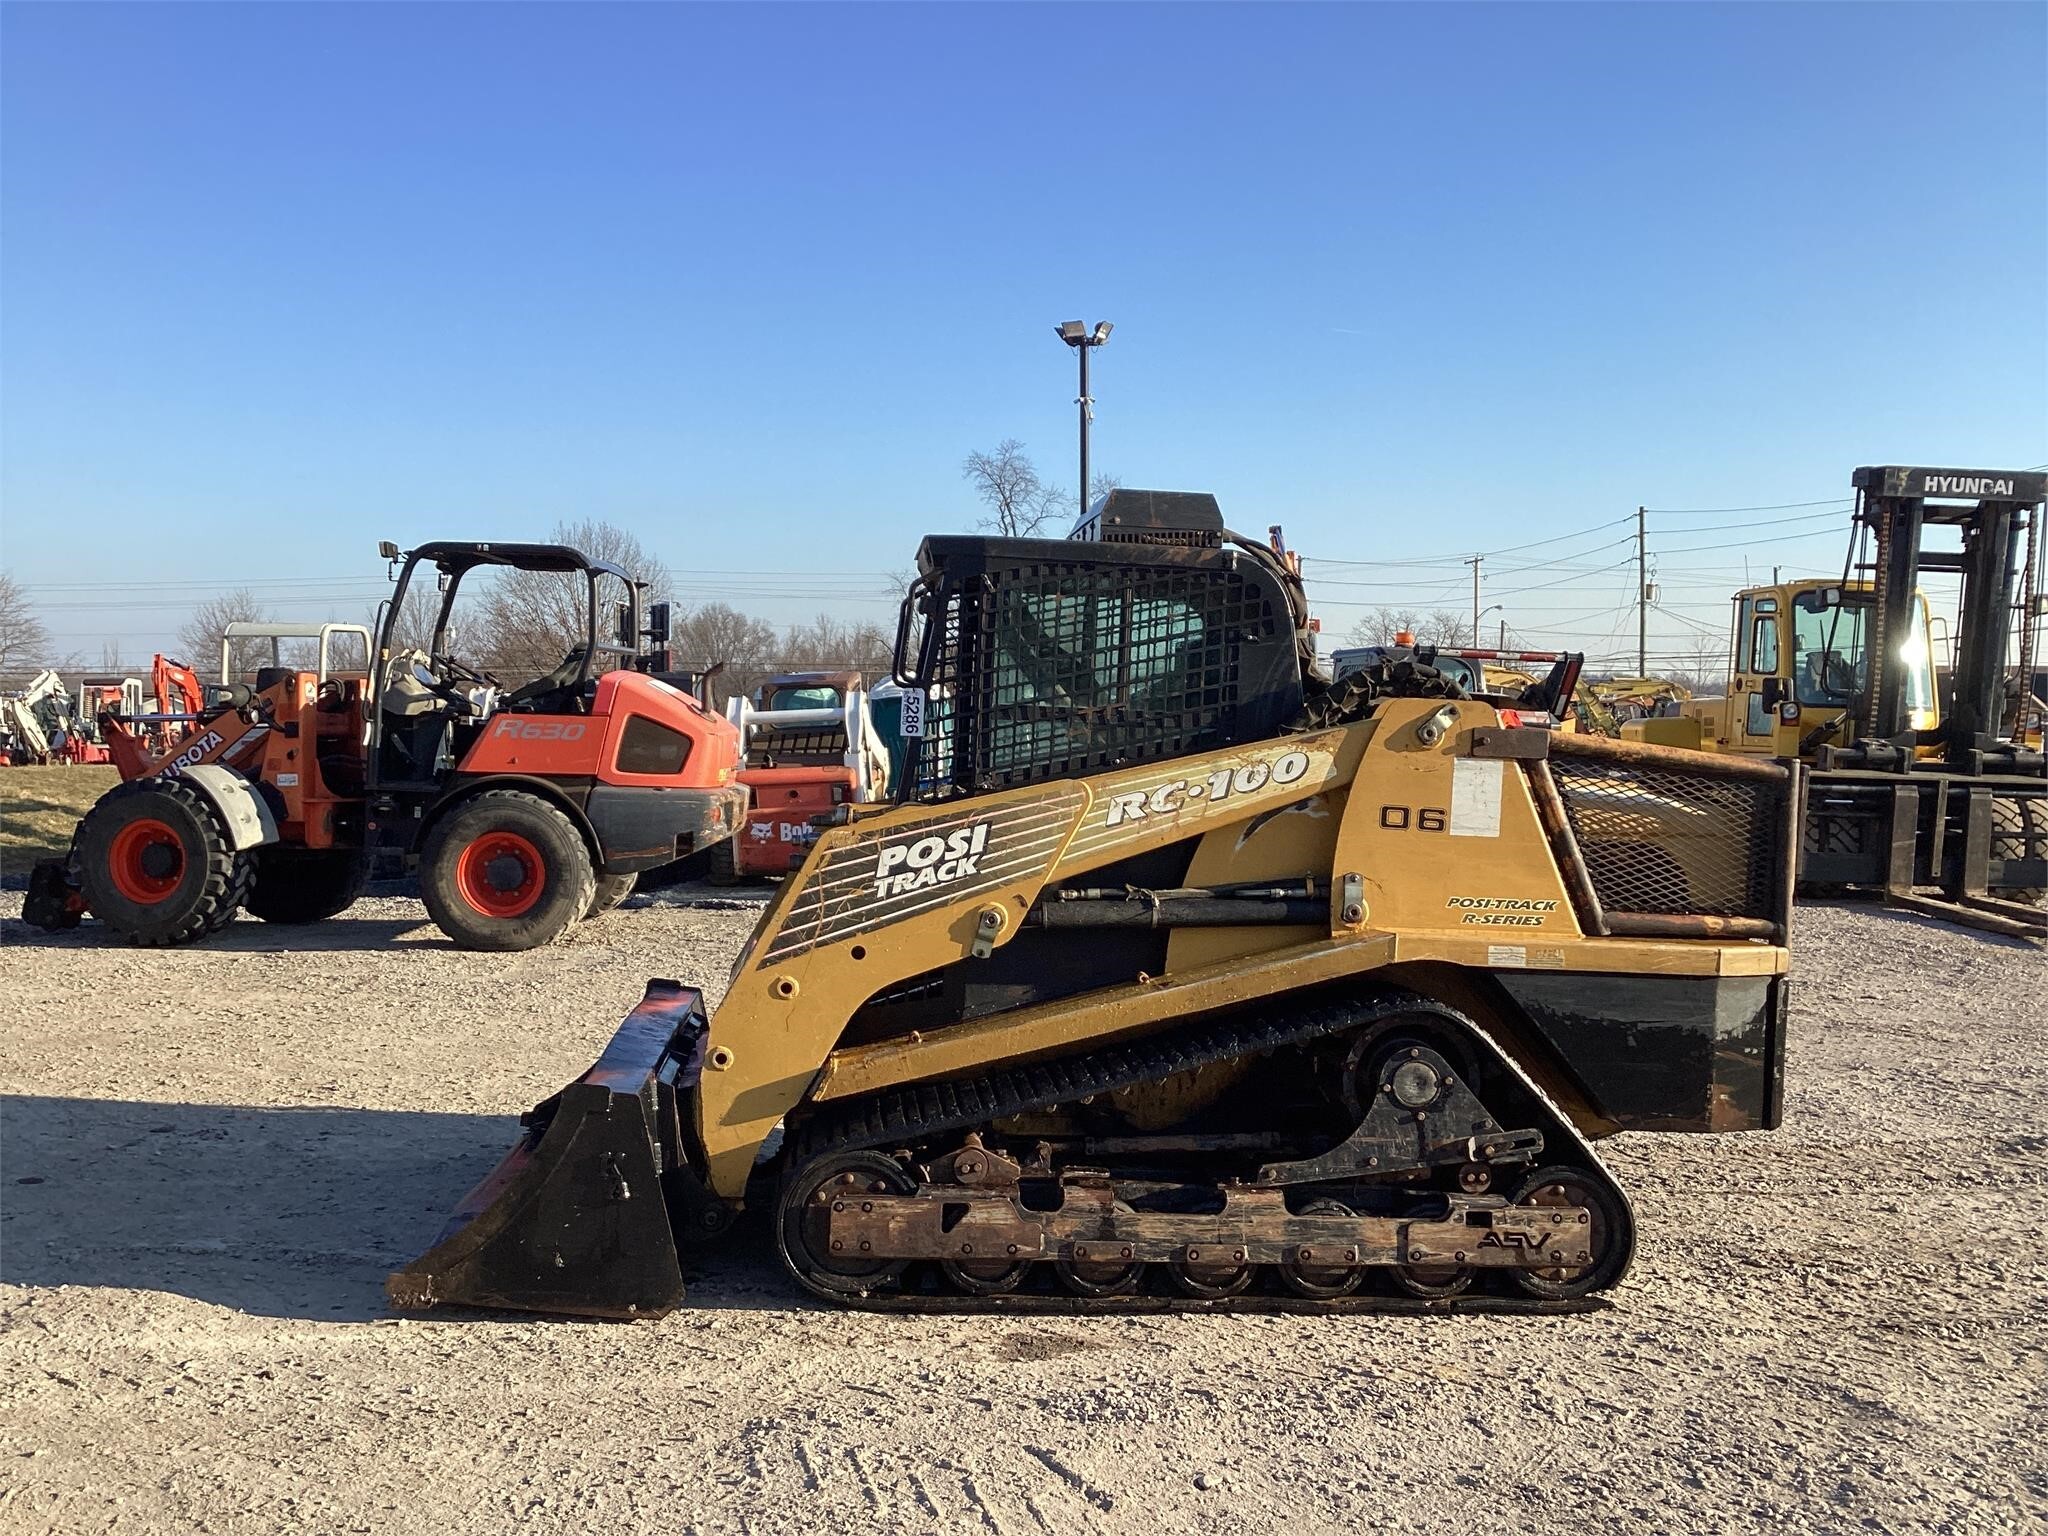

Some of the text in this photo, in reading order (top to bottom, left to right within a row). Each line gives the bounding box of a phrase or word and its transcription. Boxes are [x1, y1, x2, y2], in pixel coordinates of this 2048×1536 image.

[1924, 475, 2014, 496] HYUNDAI
[905, 696, 920, 734] 5286
[494, 719, 586, 741] R630
[160, 730, 223, 777] UBOTA
[1379, 804, 1447, 833] 06
[780, 821, 815, 842] Bob
[876, 823, 988, 878] POSI
[873, 854, 980, 898] TRACK
[1446, 897, 1558, 911] POSI-TRACK
[1461, 913, 1545, 926] R-SERIES
[1477, 1231, 1552, 1249] ASV
